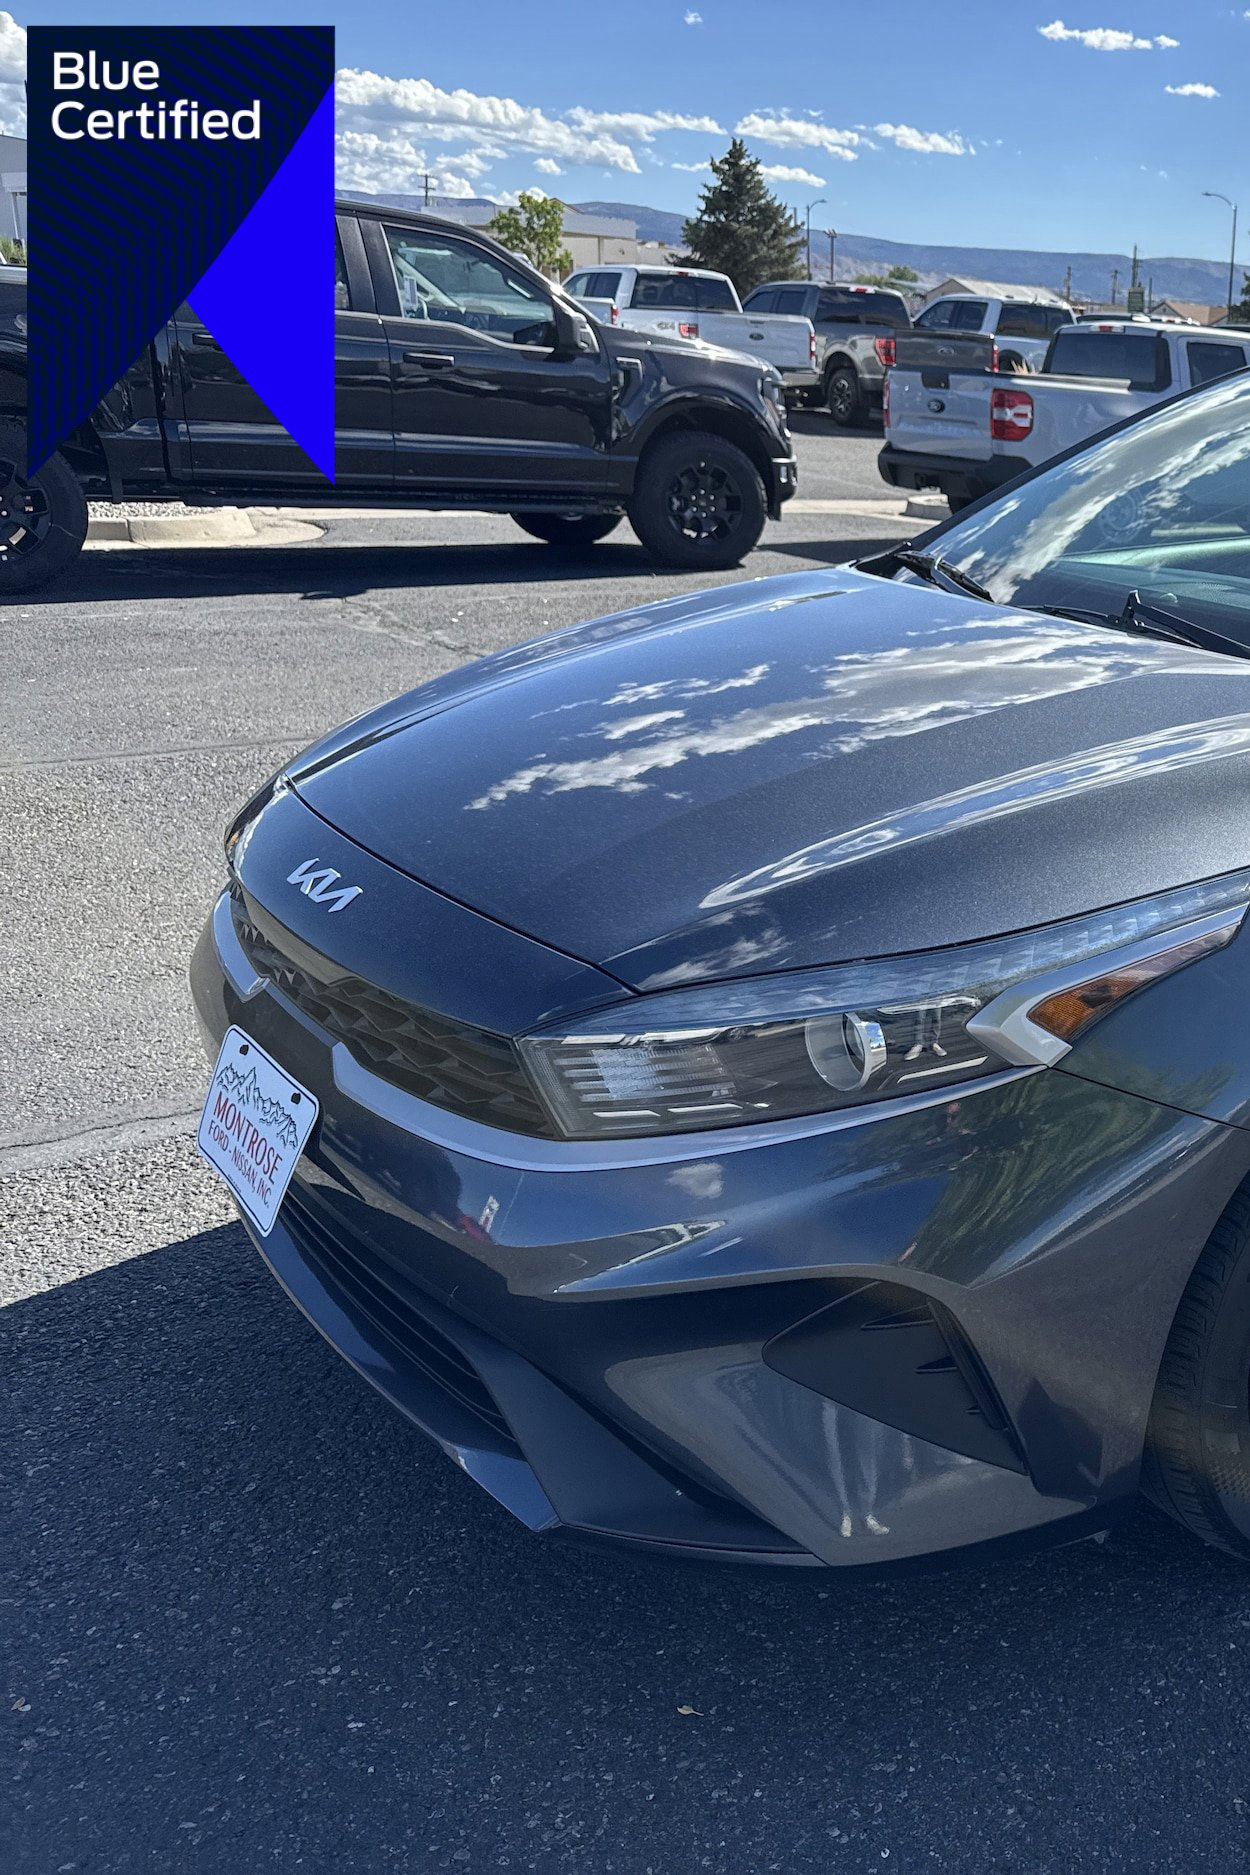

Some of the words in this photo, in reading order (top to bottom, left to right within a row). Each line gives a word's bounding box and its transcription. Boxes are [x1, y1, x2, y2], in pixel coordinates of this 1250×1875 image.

[286, 858, 363, 913] KIA
[207, 1120, 229, 1152] FORD
[231, 1149, 256, 1193] NISSAN,
[213, 1090, 283, 1185] MONTROSE
